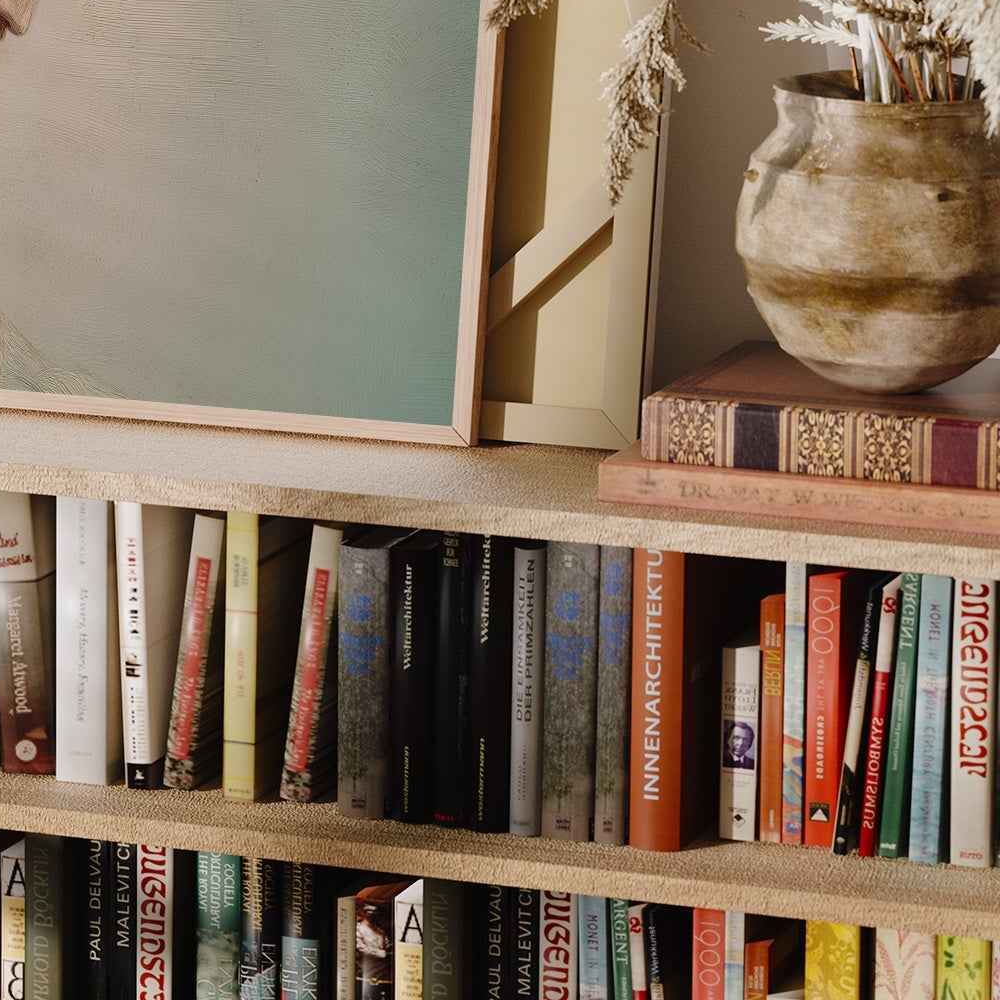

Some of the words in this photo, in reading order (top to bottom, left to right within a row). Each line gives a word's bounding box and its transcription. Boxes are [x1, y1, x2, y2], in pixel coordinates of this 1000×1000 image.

[6, 595, 23, 656] Margaret
[402, 564, 412, 670] Weltarchitektur
[516, 574, 526, 687] EINSAMKEIT
[524, 558, 535, 679] PRIMZAHLEN
[12, 660, 32, 714] Atwood
[515, 692, 525, 722] DIE
[524, 684, 533, 723] DER
[643, 549, 663, 802] INNENARCHITEKTU
[477, 737, 486, 821] westermann
[89, 840, 101, 910] DELVAU
[89, 916, 101, 961] PAUL
[586, 914, 599, 952] MONET
[613, 899, 628, 965] ARGENT
[629, 916, 642, 934] 2
[648, 925, 659, 975] Werkkunst
[693, 922, 721, 987] 1900
